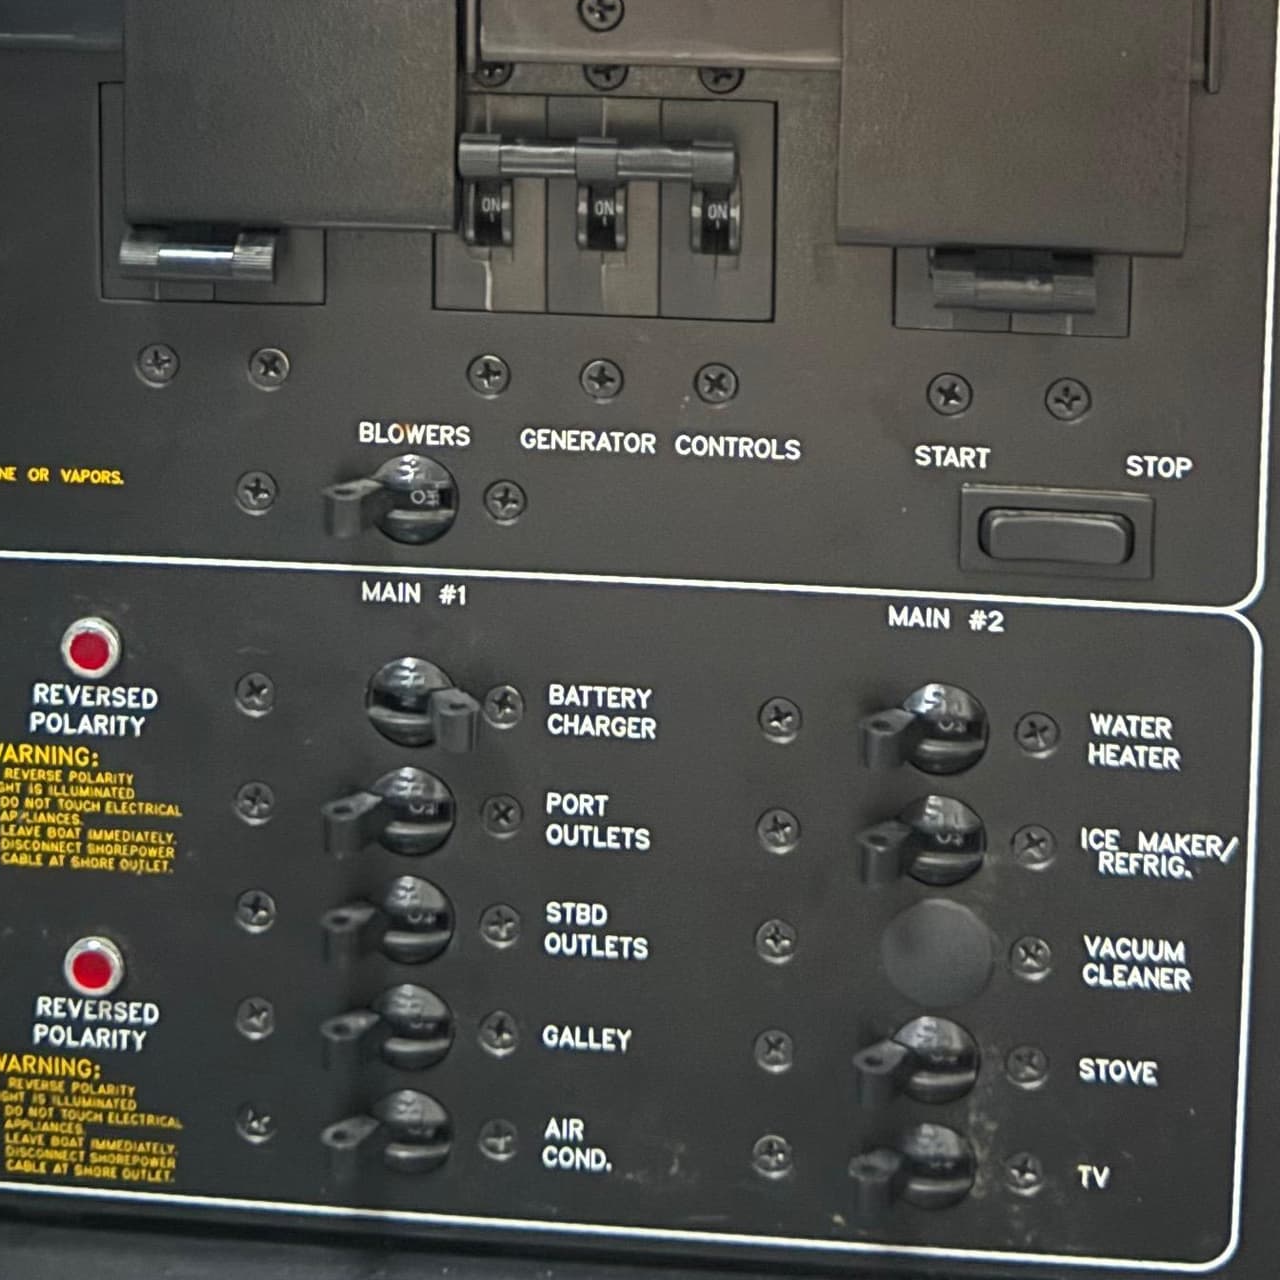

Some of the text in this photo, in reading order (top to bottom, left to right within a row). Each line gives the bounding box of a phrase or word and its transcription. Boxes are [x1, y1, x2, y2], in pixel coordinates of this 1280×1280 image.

[481, 198, 501, 213] ON
[595, 200, 614, 216] ON
[708, 204, 727, 219] ON
[360, 422, 470, 446] BLOWERS
[520, 429, 800, 460] GENERATOR CONTROLS
[915, 445, 990, 468] START
[1127, 455, 1192, 478] STOP
[28, 468, 49, 481] OR
[61, 469, 124, 484] VAPORS.
[362, 581, 465, 605] MAIN #1
[889, 605, 1004, 632] MAIN #2
[34, 683, 157, 709] REVERSED
[549, 684, 651, 709] BATTERY
[30, 712, 145, 736] POLARITY
[548, 713, 656, 739] CHARGER
[1090, 713, 1172, 740] WATER
[1088, 743, 1180, 770] HEATER
[547, 792, 608, 816] PORT
[546, 824, 650, 850] OUTLETS
[1082, 827, 1239, 863] ICE MAKER/
[1099, 851, 1192, 878] REFRIG.
[547, 902, 607, 926] STBD
[545, 932, 648, 959] OUTLETS
[1084, 935, 1185, 963] VACUUM
[1083, 963, 1191, 991] CLEANER
[37, 996, 159, 1025] REVERSED
[34, 1024, 146, 1050] POLARITY
[543, 1025, 631, 1051] GALLEY
[1080, 1058, 1157, 1085] STOVE
[545, 1118, 584, 1141] AIR
[543, 1146, 611, 1171] COND.
[1078, 1165, 1109, 1188] TV
